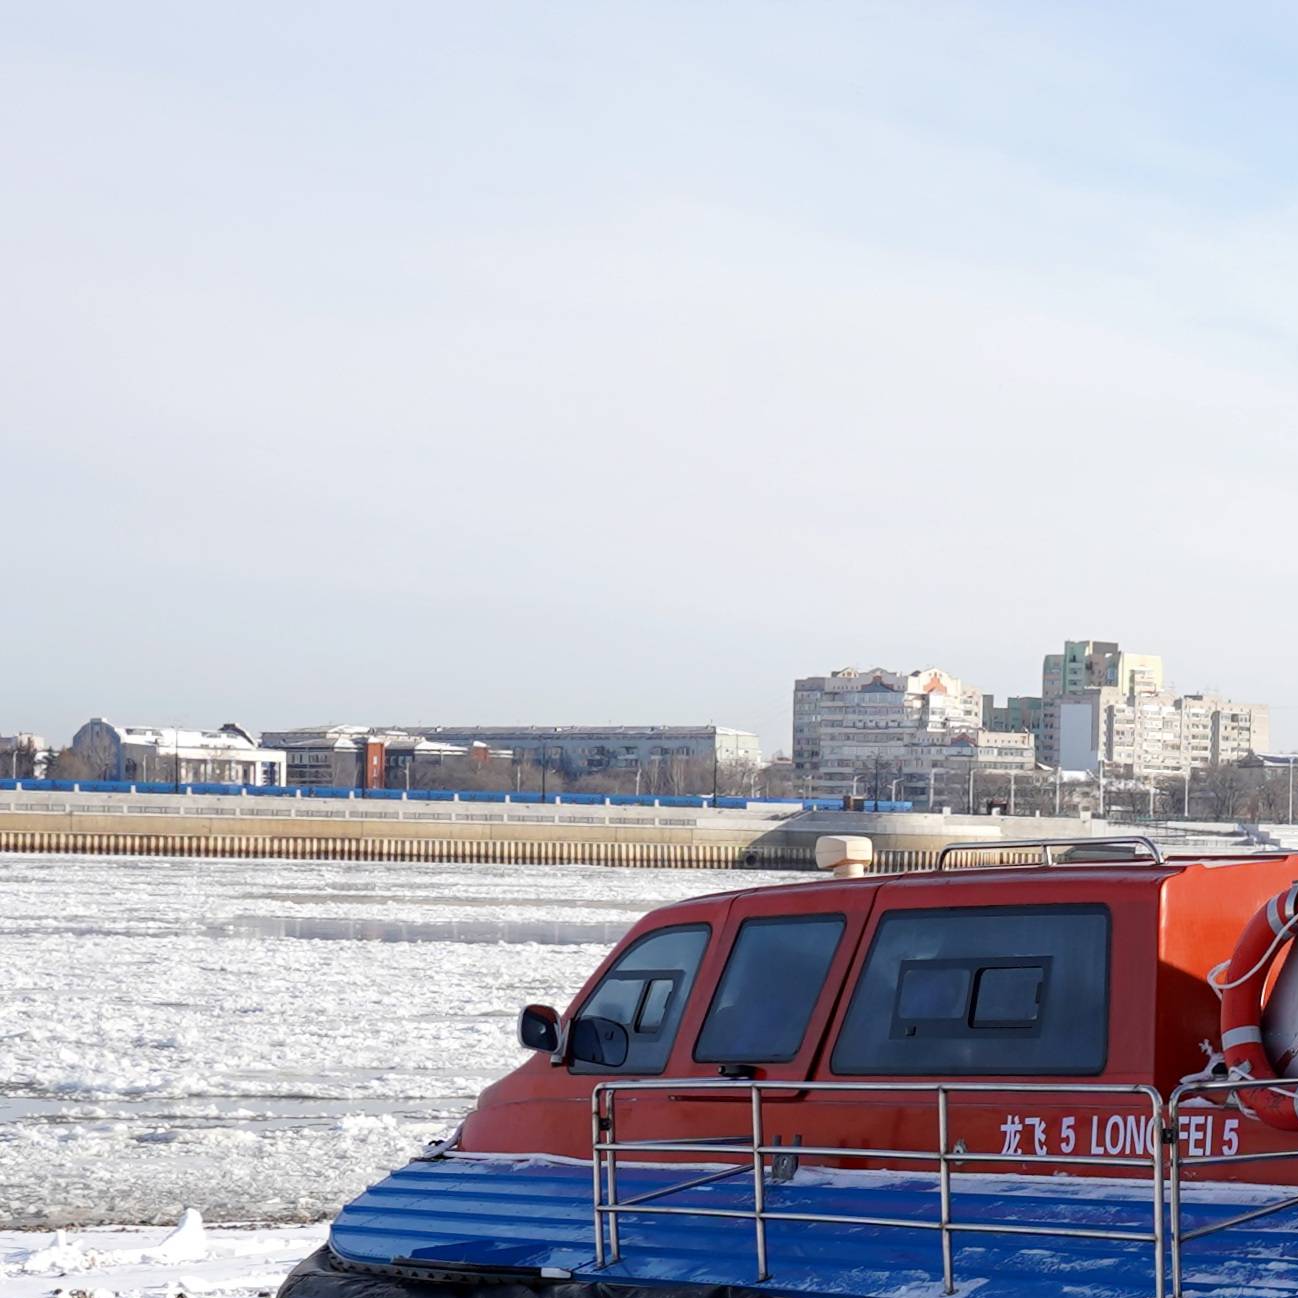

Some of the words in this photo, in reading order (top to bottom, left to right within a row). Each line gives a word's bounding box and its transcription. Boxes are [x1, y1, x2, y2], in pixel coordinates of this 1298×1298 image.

[1000, 1114, 1047, 1155] 龙飞
[1060, 1116, 1075, 1153] 5
[1222, 1119, 1239, 1156] 5
